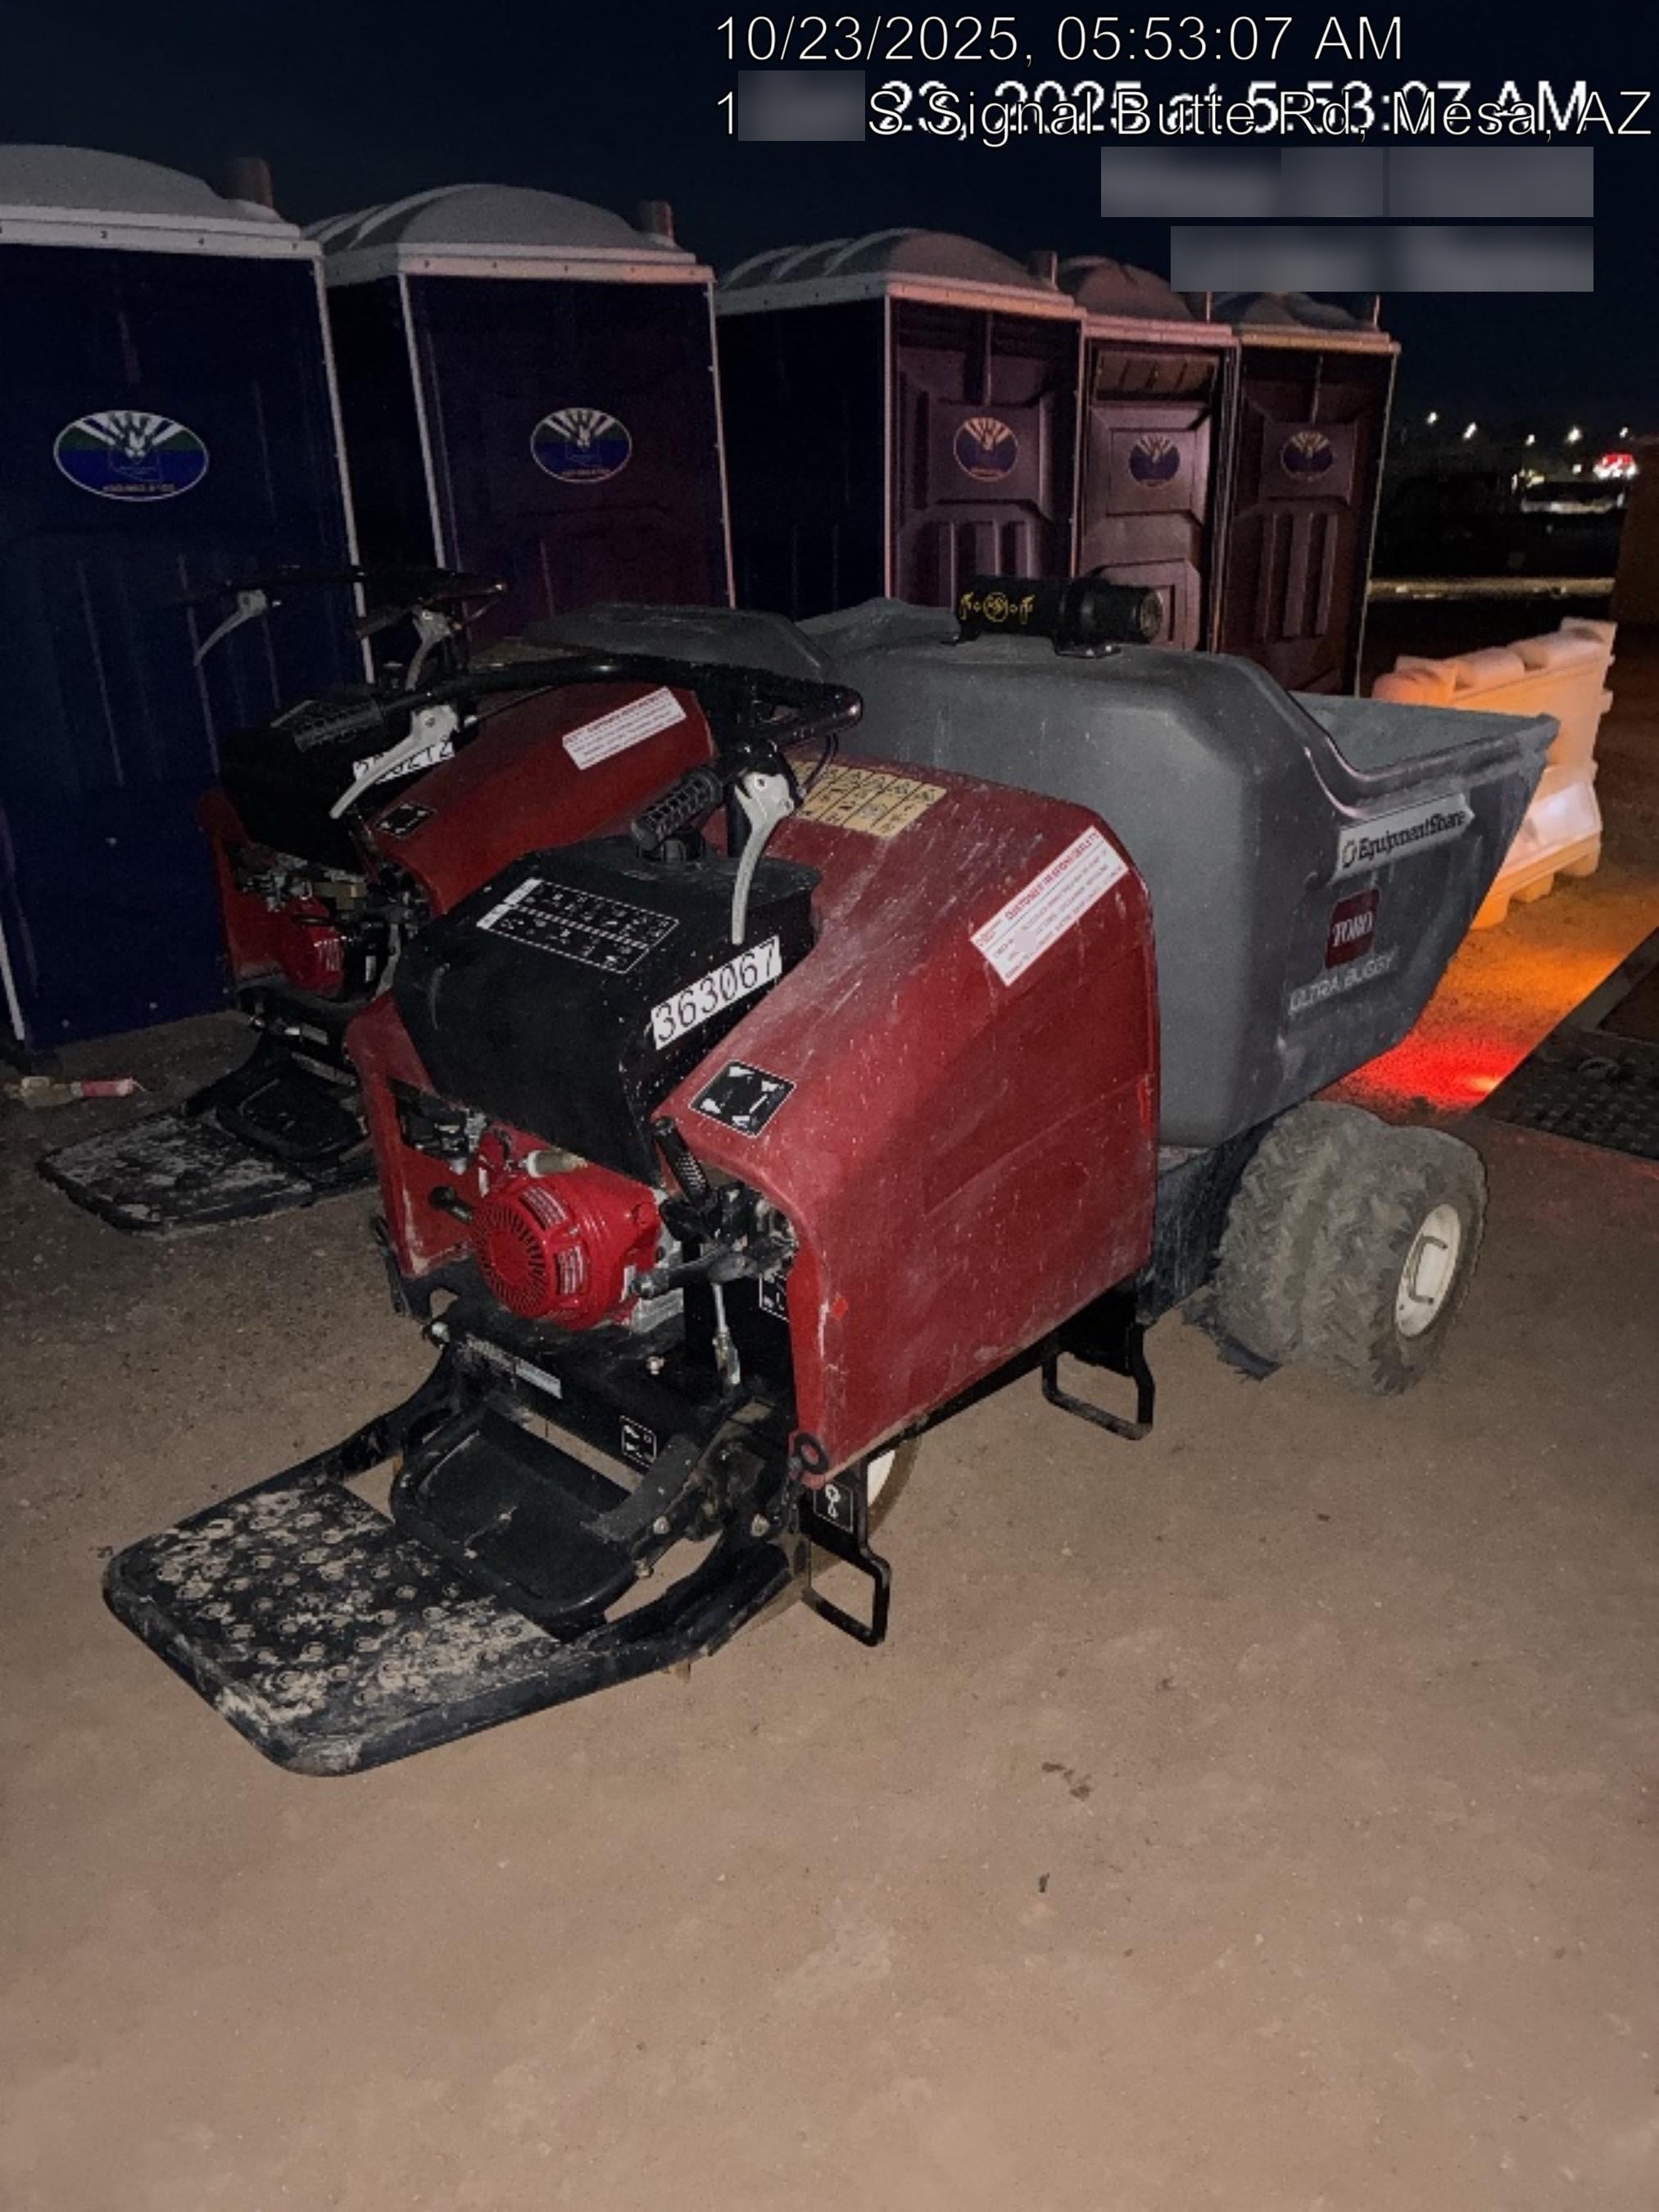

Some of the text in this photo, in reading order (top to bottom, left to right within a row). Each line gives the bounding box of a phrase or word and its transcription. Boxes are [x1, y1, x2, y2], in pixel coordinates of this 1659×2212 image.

[1358, 810, 1466, 860] EquipmentShare
[1333, 911, 1374, 948] TORO
[655, 938, 777, 1041] 363067
